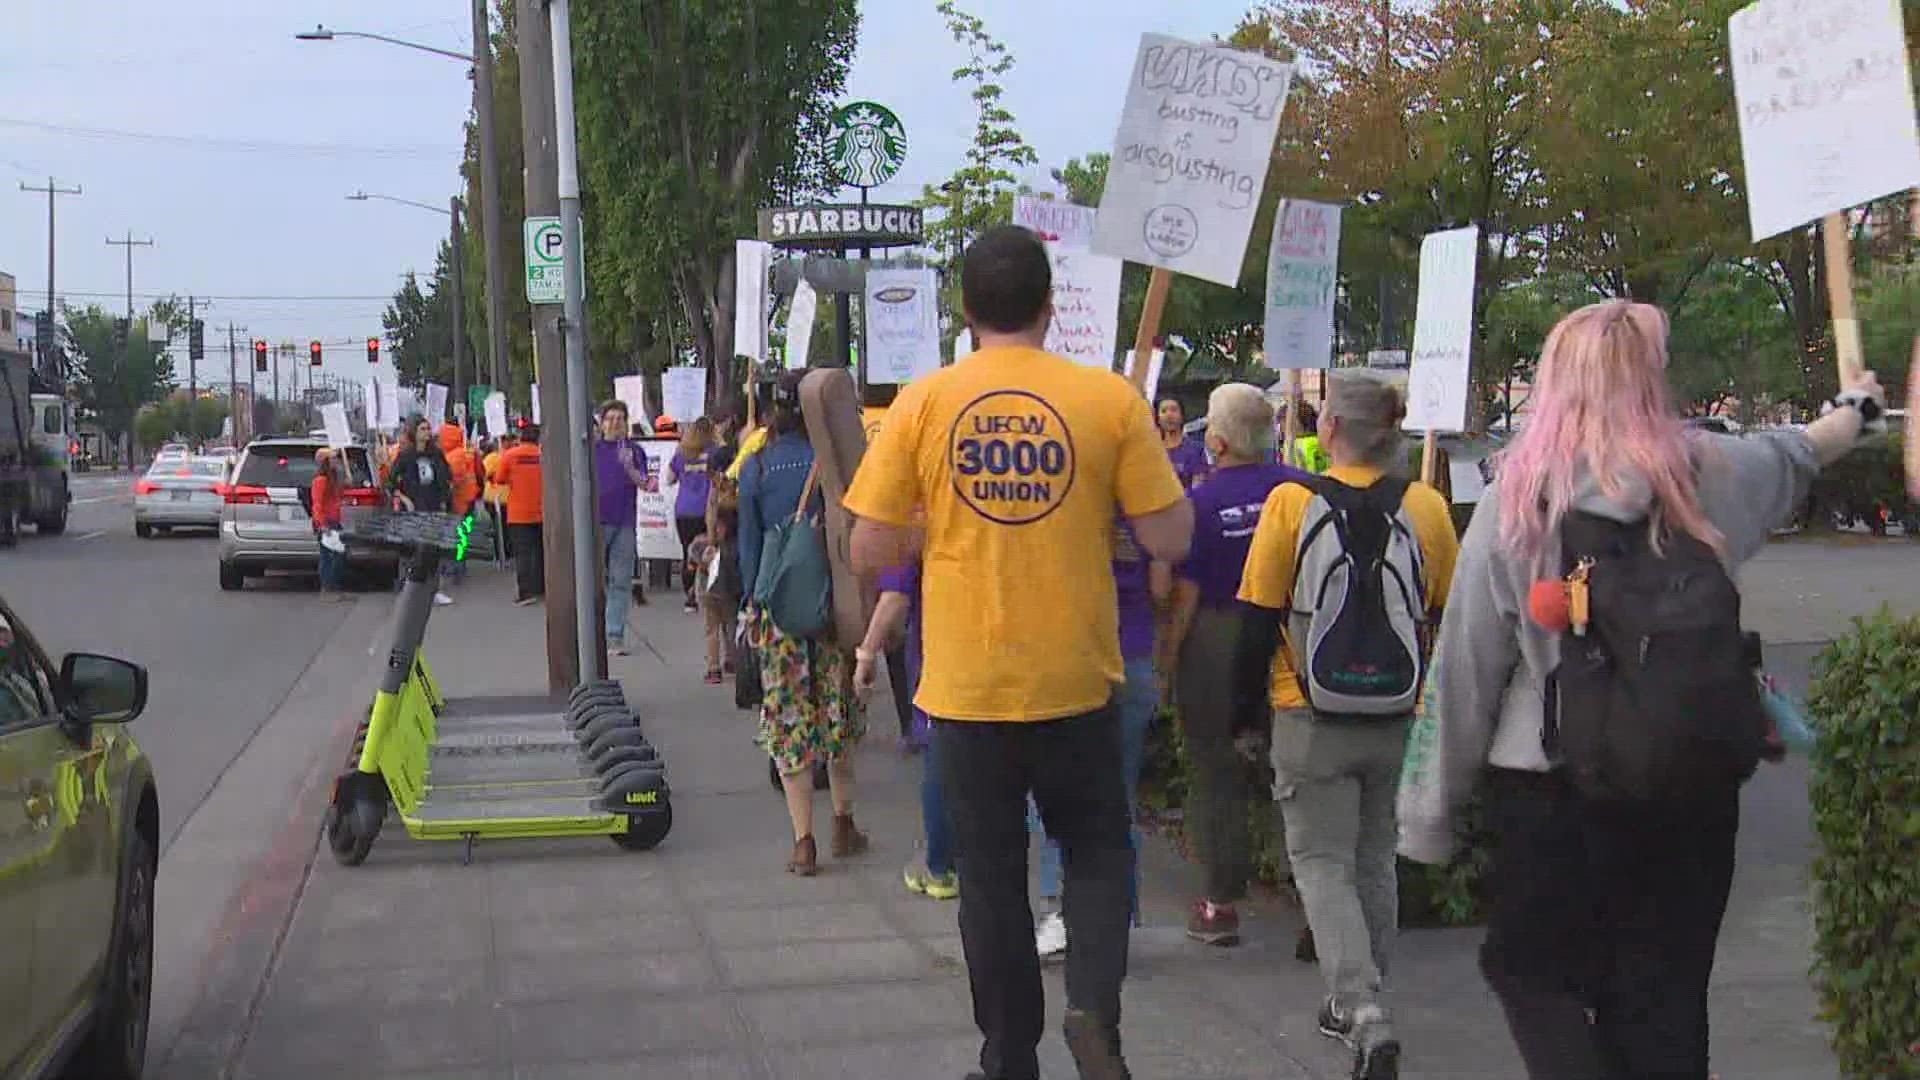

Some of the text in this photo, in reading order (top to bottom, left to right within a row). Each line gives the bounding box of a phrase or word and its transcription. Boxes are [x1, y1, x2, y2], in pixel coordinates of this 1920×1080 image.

[1158, 97, 1239, 143] busting
[1123, 143, 1254, 210] disgusting
[772, 208, 921, 237] STARBUCKS
[545, 233, 562, 255] P
[974, 414, 1046, 435] UFCW
[957, 438, 1065, 476] 3000
[973, 480, 1051, 502] UNION
